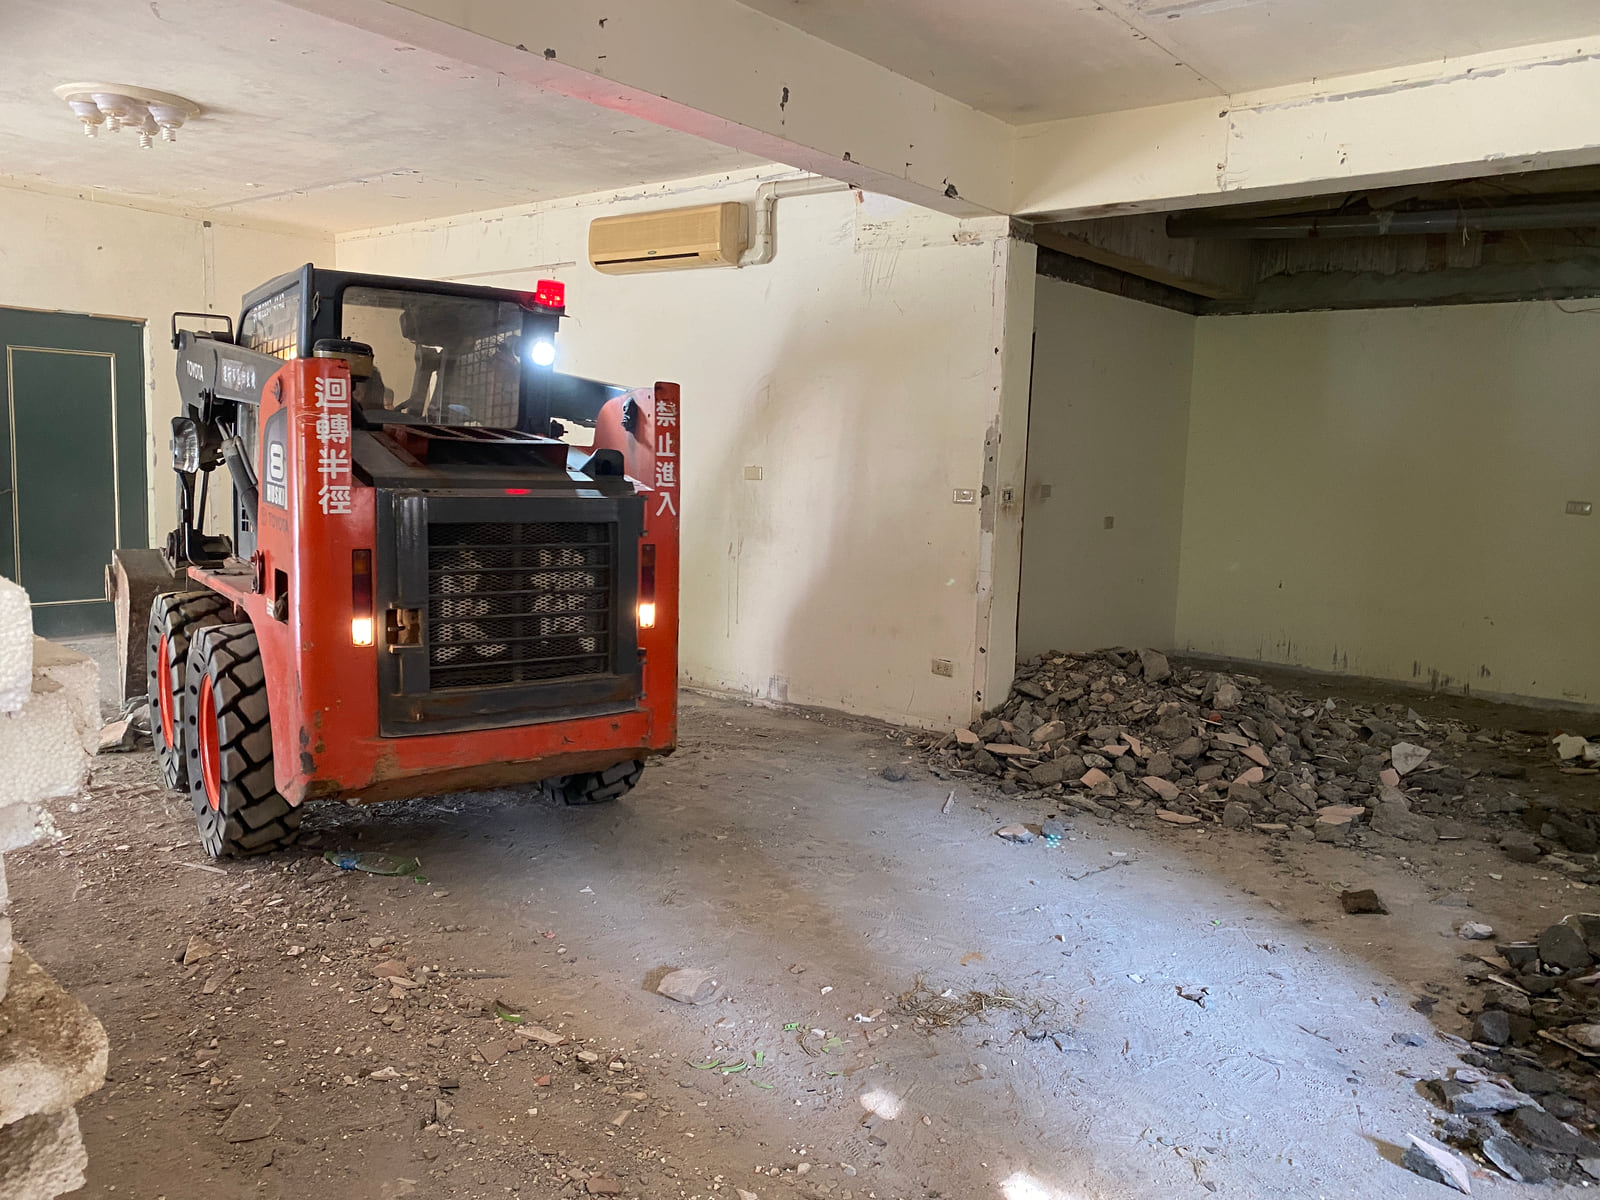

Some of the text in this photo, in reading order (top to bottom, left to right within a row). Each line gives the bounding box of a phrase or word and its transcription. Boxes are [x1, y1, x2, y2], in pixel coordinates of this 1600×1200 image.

[186, 359, 204, 382] TOYOTA
[270, 441, 284, 481] 8
[315, 377, 352, 515] 迴轉半徑
[656, 400, 677, 517] 禁止進入
